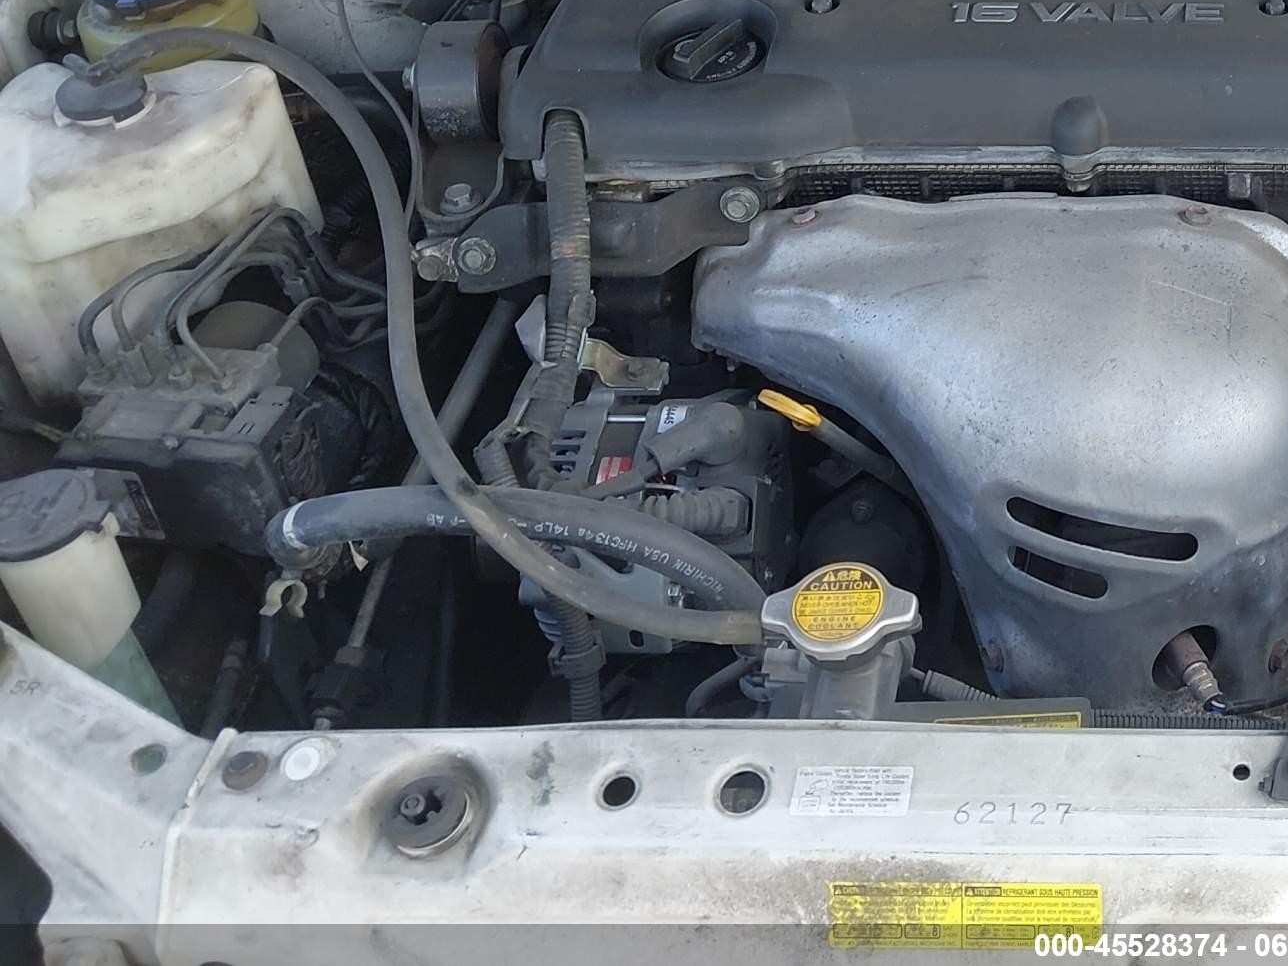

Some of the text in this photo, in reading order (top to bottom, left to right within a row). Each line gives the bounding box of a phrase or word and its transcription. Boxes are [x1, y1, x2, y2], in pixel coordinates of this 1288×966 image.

[951, 1, 1225, 25] 16 VALVE
[535, 522, 570, 536] 14LP
[642, 546, 669, 565] USA
[810, 581, 873, 591] CAUTION
[953, 801, 1073, 825] 62127
